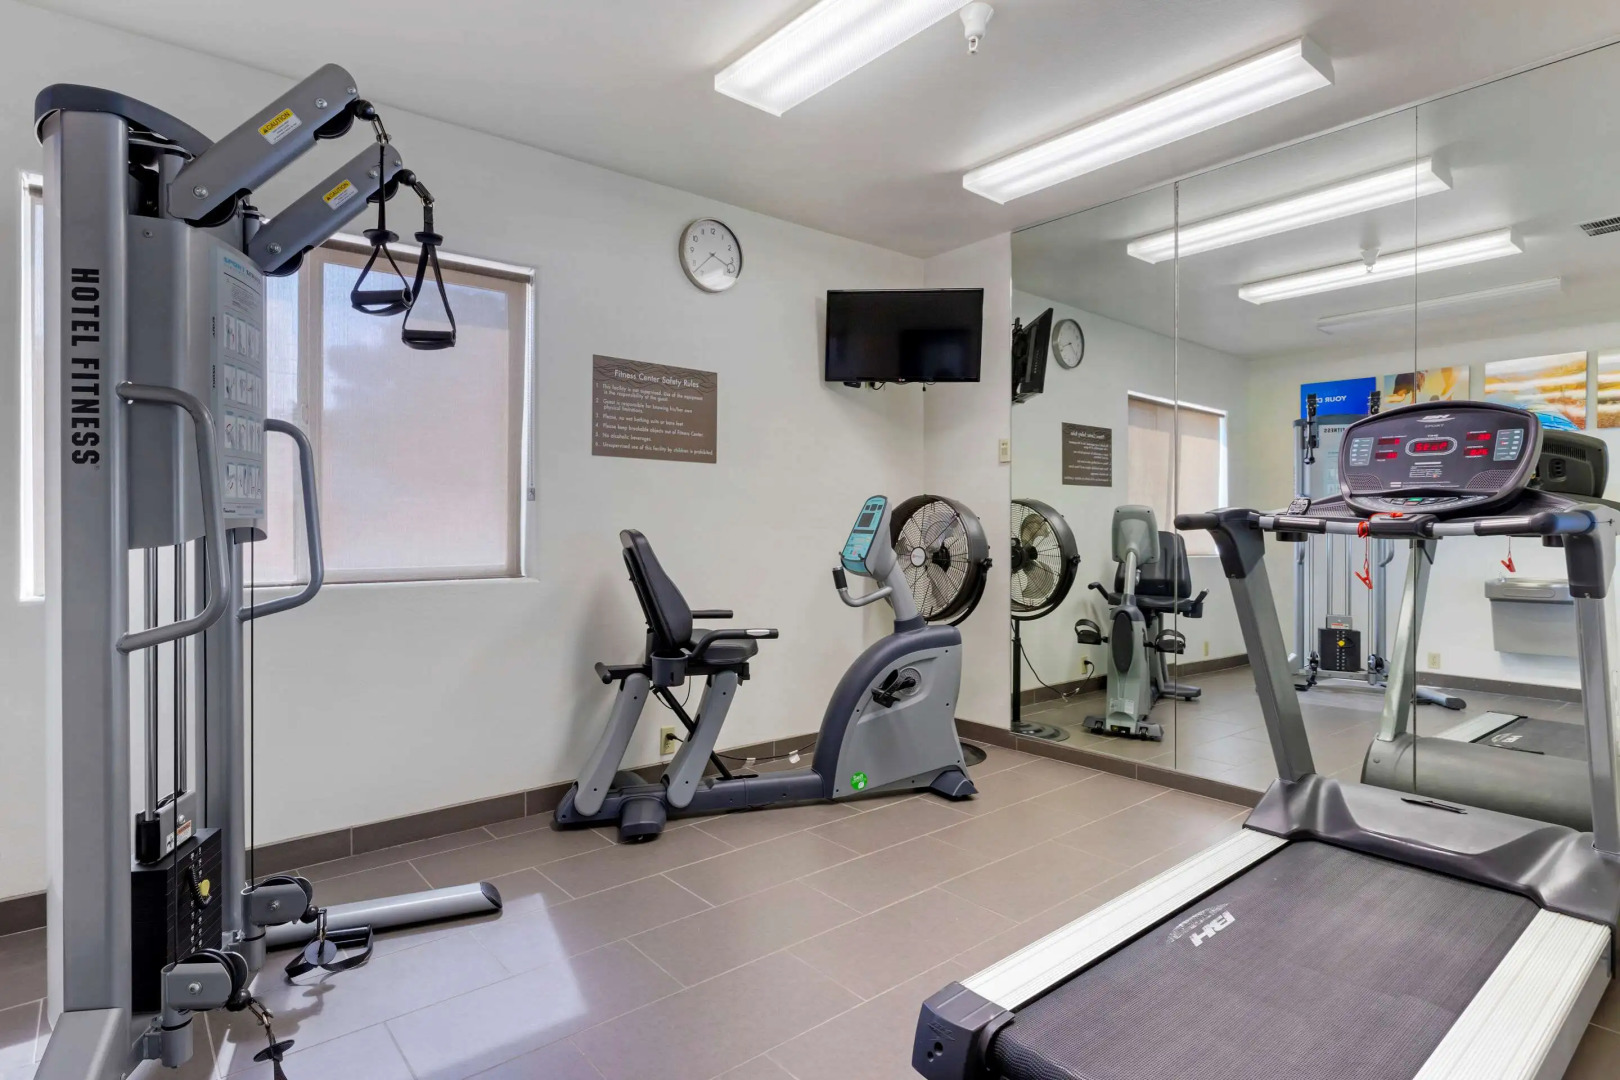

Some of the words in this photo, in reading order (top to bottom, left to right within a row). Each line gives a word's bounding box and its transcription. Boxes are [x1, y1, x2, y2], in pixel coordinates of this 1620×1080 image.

[266, 111, 290, 130] CAUTION
[329, 182, 349, 198] CAUTION
[71, 268, 100, 346] HOTEL
[614, 370, 636, 380] Fitness
[638, 372, 660, 383] Center
[662, 376, 682, 387] Safety
[683, 380, 699, 388] Rules
[71, 358, 100, 464] FITNESS
[1189, 910, 1235, 947] BH
